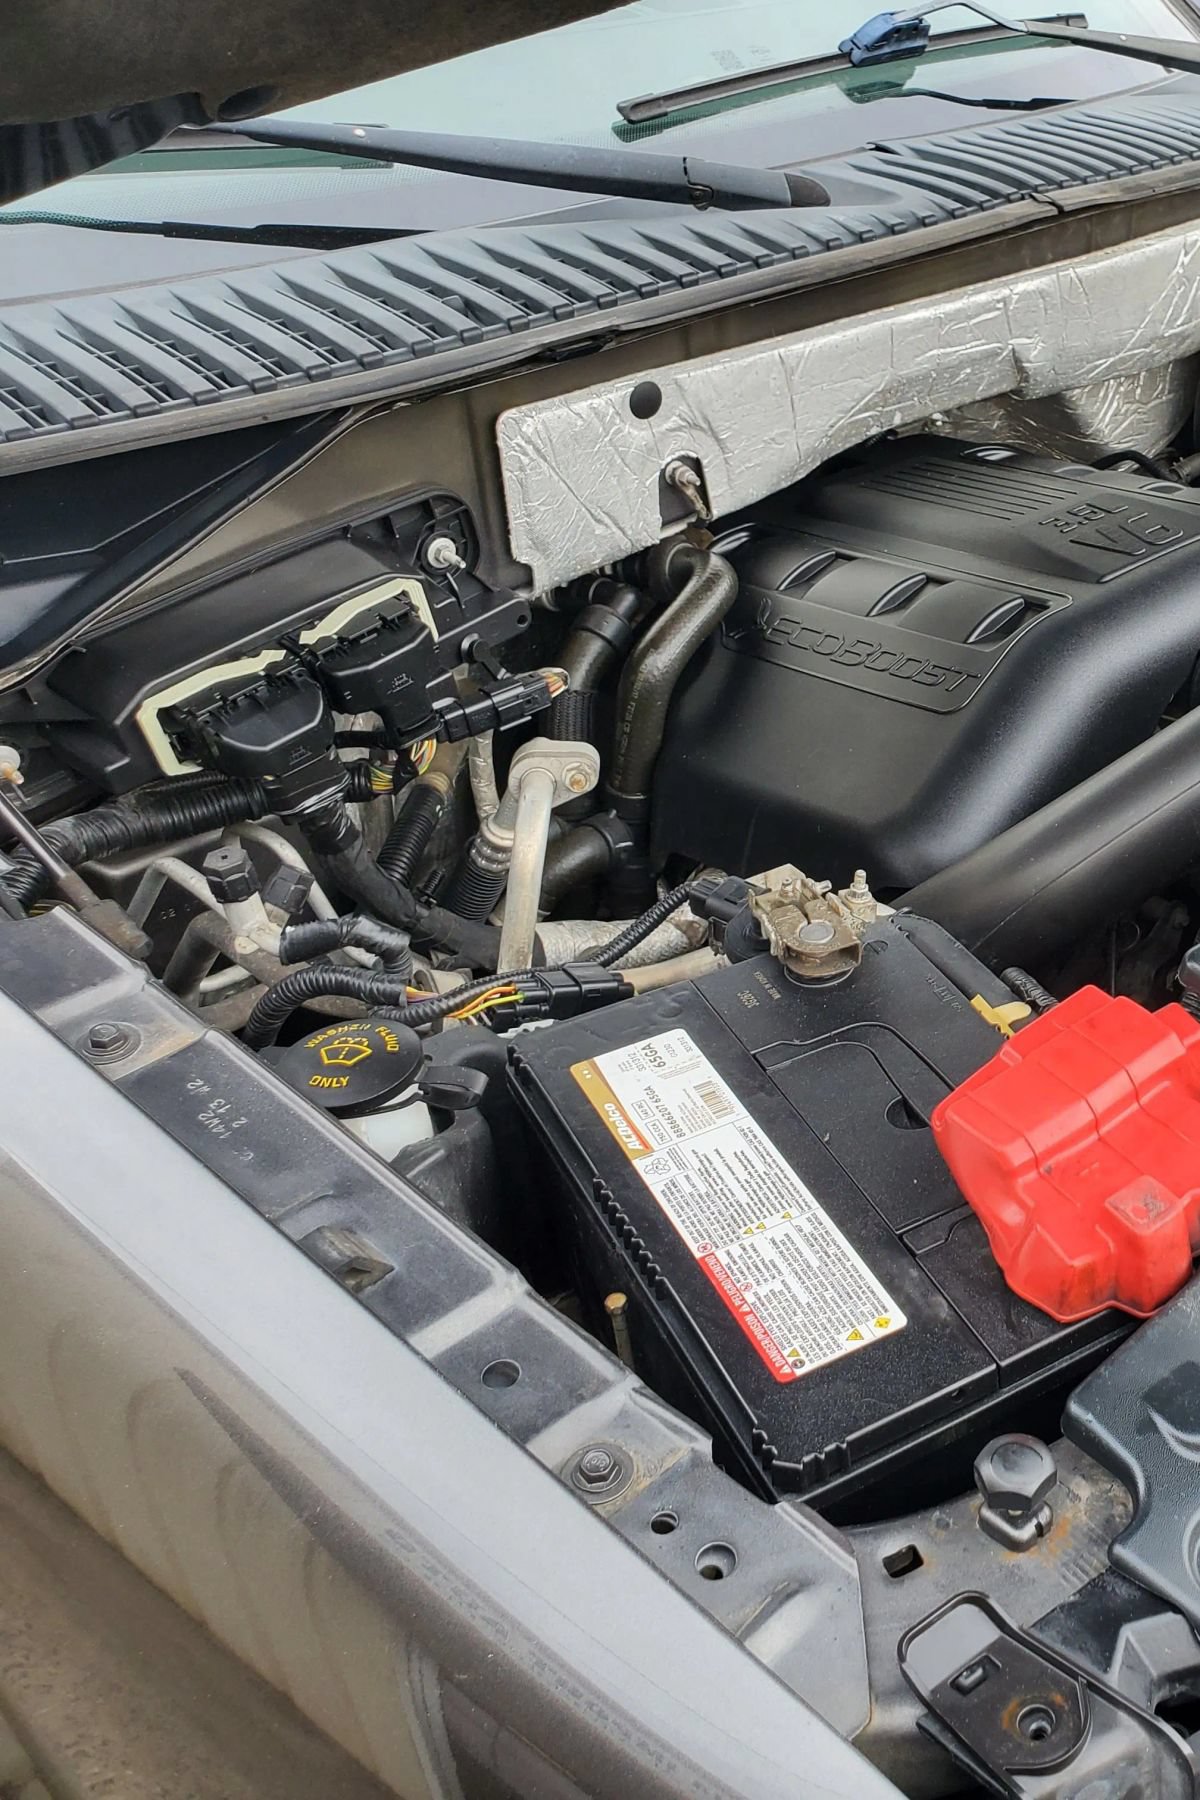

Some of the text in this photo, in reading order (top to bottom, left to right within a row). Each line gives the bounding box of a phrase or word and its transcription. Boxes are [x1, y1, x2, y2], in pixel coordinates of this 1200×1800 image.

[1069, 512, 1184, 557] V6
[303, 1023, 400, 1052] WASHER FLUID
[641, 1042, 666, 1069] 65GA
[308, 1075, 350, 1088] ONLY
[642, 1085, 662, 1104] 65GA
[603, 1102, 645, 1151] ACDelco
[654, 1102, 686, 1139] 88866207
[655, 1131, 668, 1142] 750
[744, 1313, 788, 1368] DANGER/POISON
